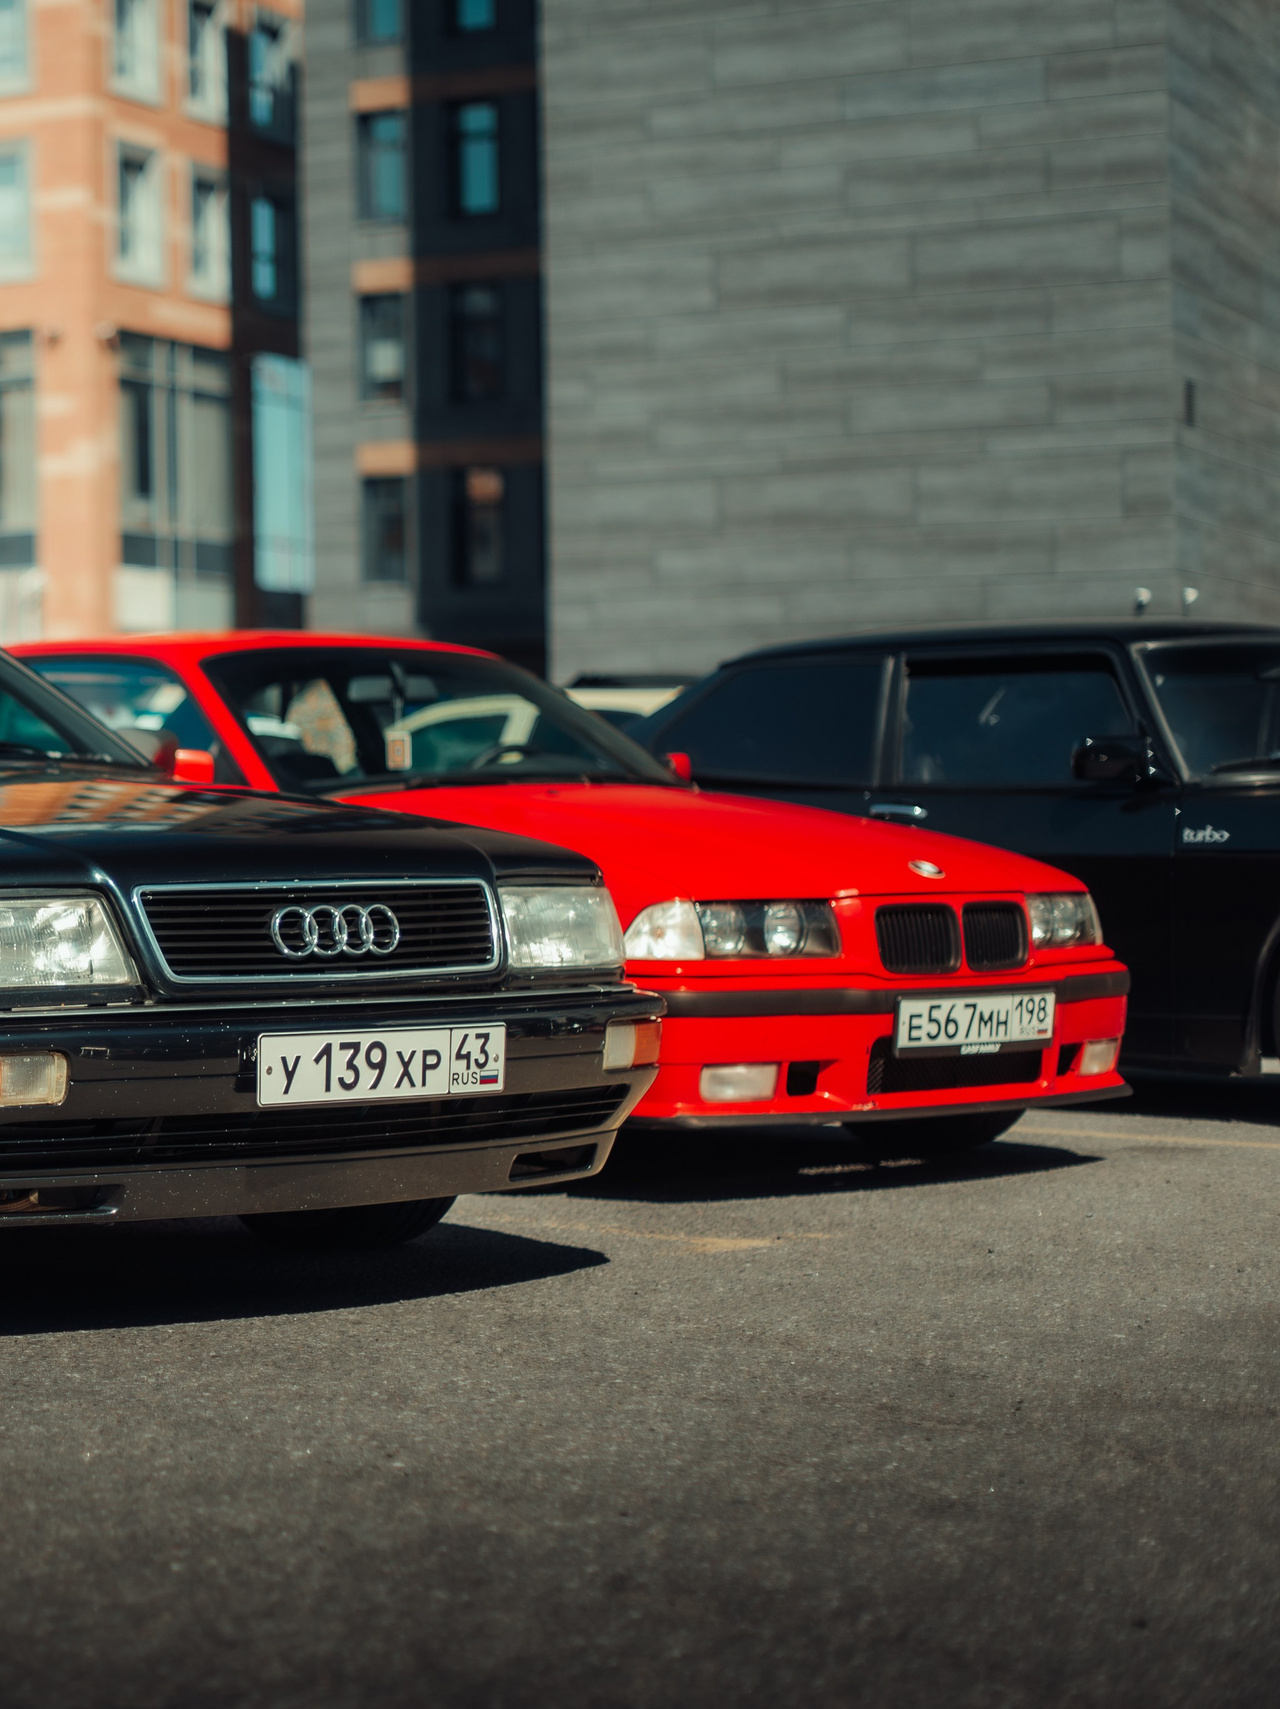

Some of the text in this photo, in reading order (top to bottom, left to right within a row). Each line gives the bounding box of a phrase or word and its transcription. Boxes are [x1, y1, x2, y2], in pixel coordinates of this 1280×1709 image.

[1182, 824, 1230, 843] turbo
[1015, 997, 1048, 1026] 198
[455, 1032, 491, 1071] 43
[452, 1071, 478, 1086] RUS
